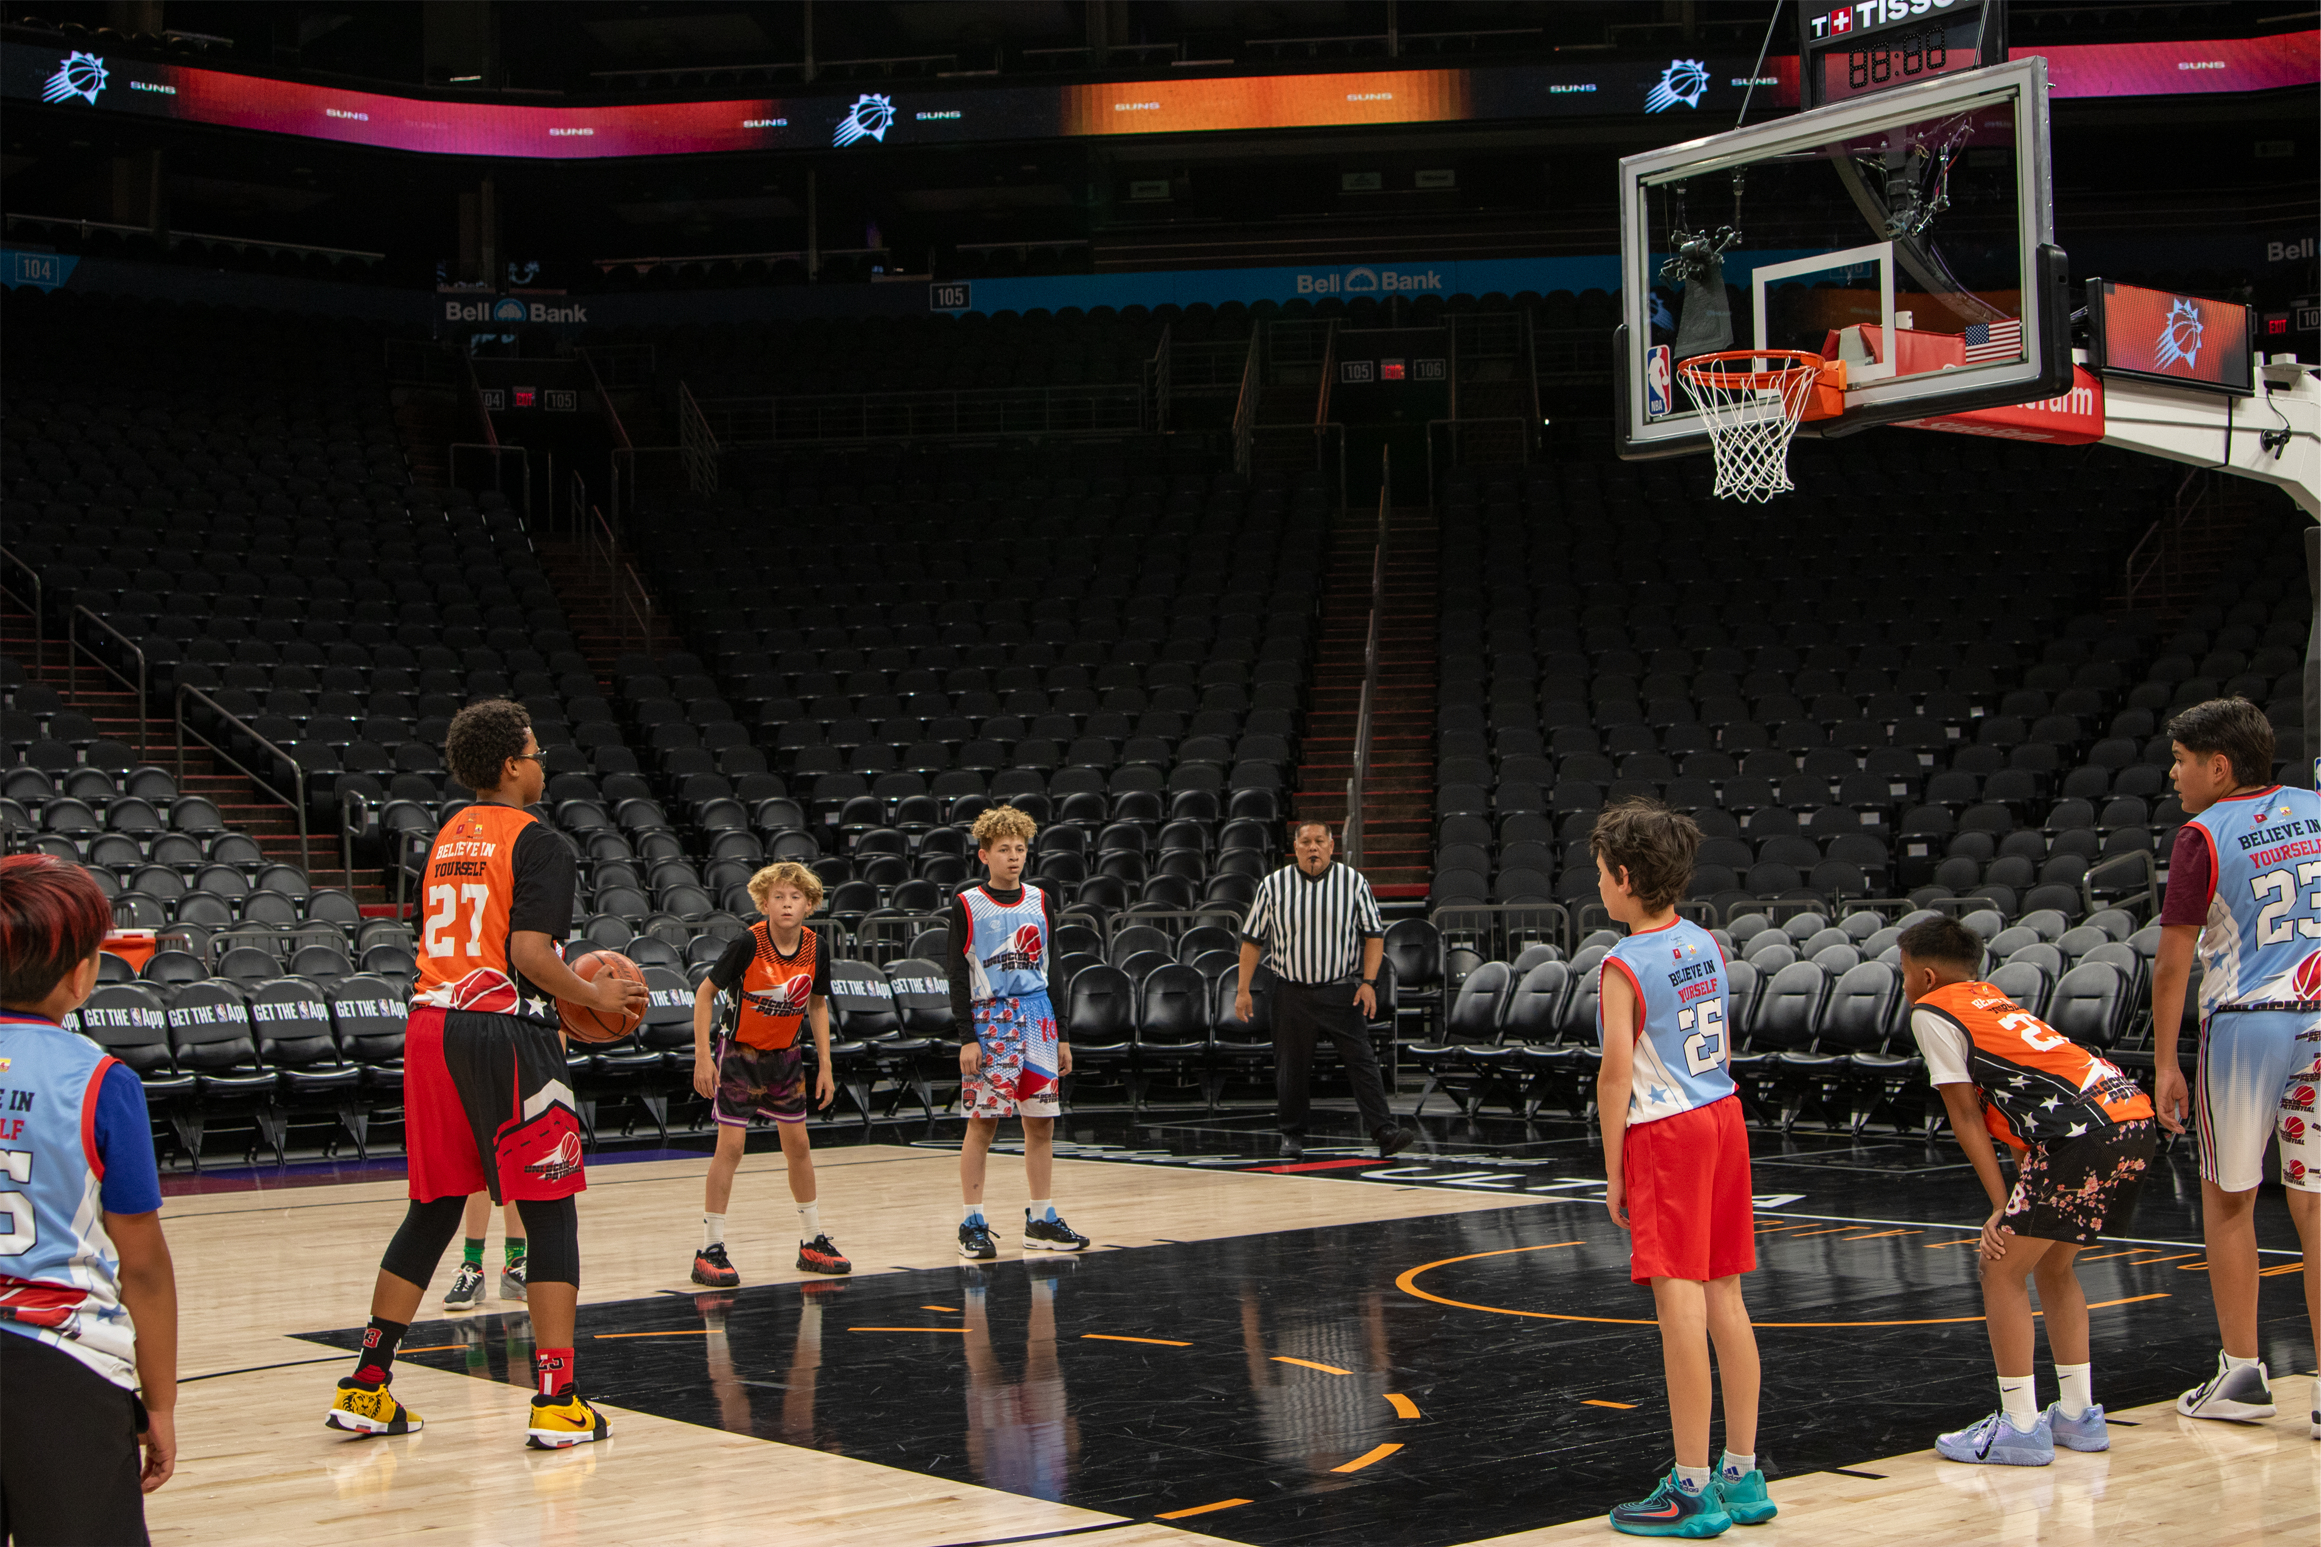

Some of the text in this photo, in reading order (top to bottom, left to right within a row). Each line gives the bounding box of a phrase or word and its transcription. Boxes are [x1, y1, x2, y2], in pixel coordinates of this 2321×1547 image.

[1856, 0, 1956, 28] TISS
[2178, 61, 2226, 70] SUNS
[130, 81, 176, 95] SUNS
[1550, 84, 1597, 94] SUNS
[1731, 77, 1779, 87] SUNS
[1346, 92, 1393, 101] SUNS
[326, 108, 369, 122] SUNS
[1115, 102, 1160, 111] SUNS
[743, 118, 788, 129] SUNS
[916, 110, 962, 121] SUNS
[549, 127, 594, 136] SUNS
[2268, 238, 2314, 262] Bell
[23, 258, 51, 281] 104
[1297, 270, 1442, 294] Bell Bank
[938, 287, 964, 306] 105
[446, 301, 588, 323] Bell Bank
[2304, 309, 2321, 327] 10
[1347, 364, 1369, 379] 105
[1420, 362, 1442, 377] 106
[482, 393, 500, 407] 04
[551, 394, 572, 408] 105
[2238, 819, 2321, 850] BELIEVE IN
[436, 841, 496, 860] BELIEVE IN
[434, 861, 487, 878] YOURSELF
[425, 883, 489, 959] 27
[1703, 959, 1716, 975] IN
[830, 980, 893, 999] GET THE App
[890, 979, 910, 995] GET
[907, 978, 926, 994] THE
[650, 990, 671, 1006] THE
[84, 1007, 165, 1029] GET THE App
[167, 1003, 249, 1028] GET THE App
[252, 1000, 329, 1022] GET THE App
[334, 1001, 358, 1019] GET
[356, 1000, 379, 1017] THE
[1677, 996, 1726, 1078] 25
[9, 1090, 34, 1112] IN
